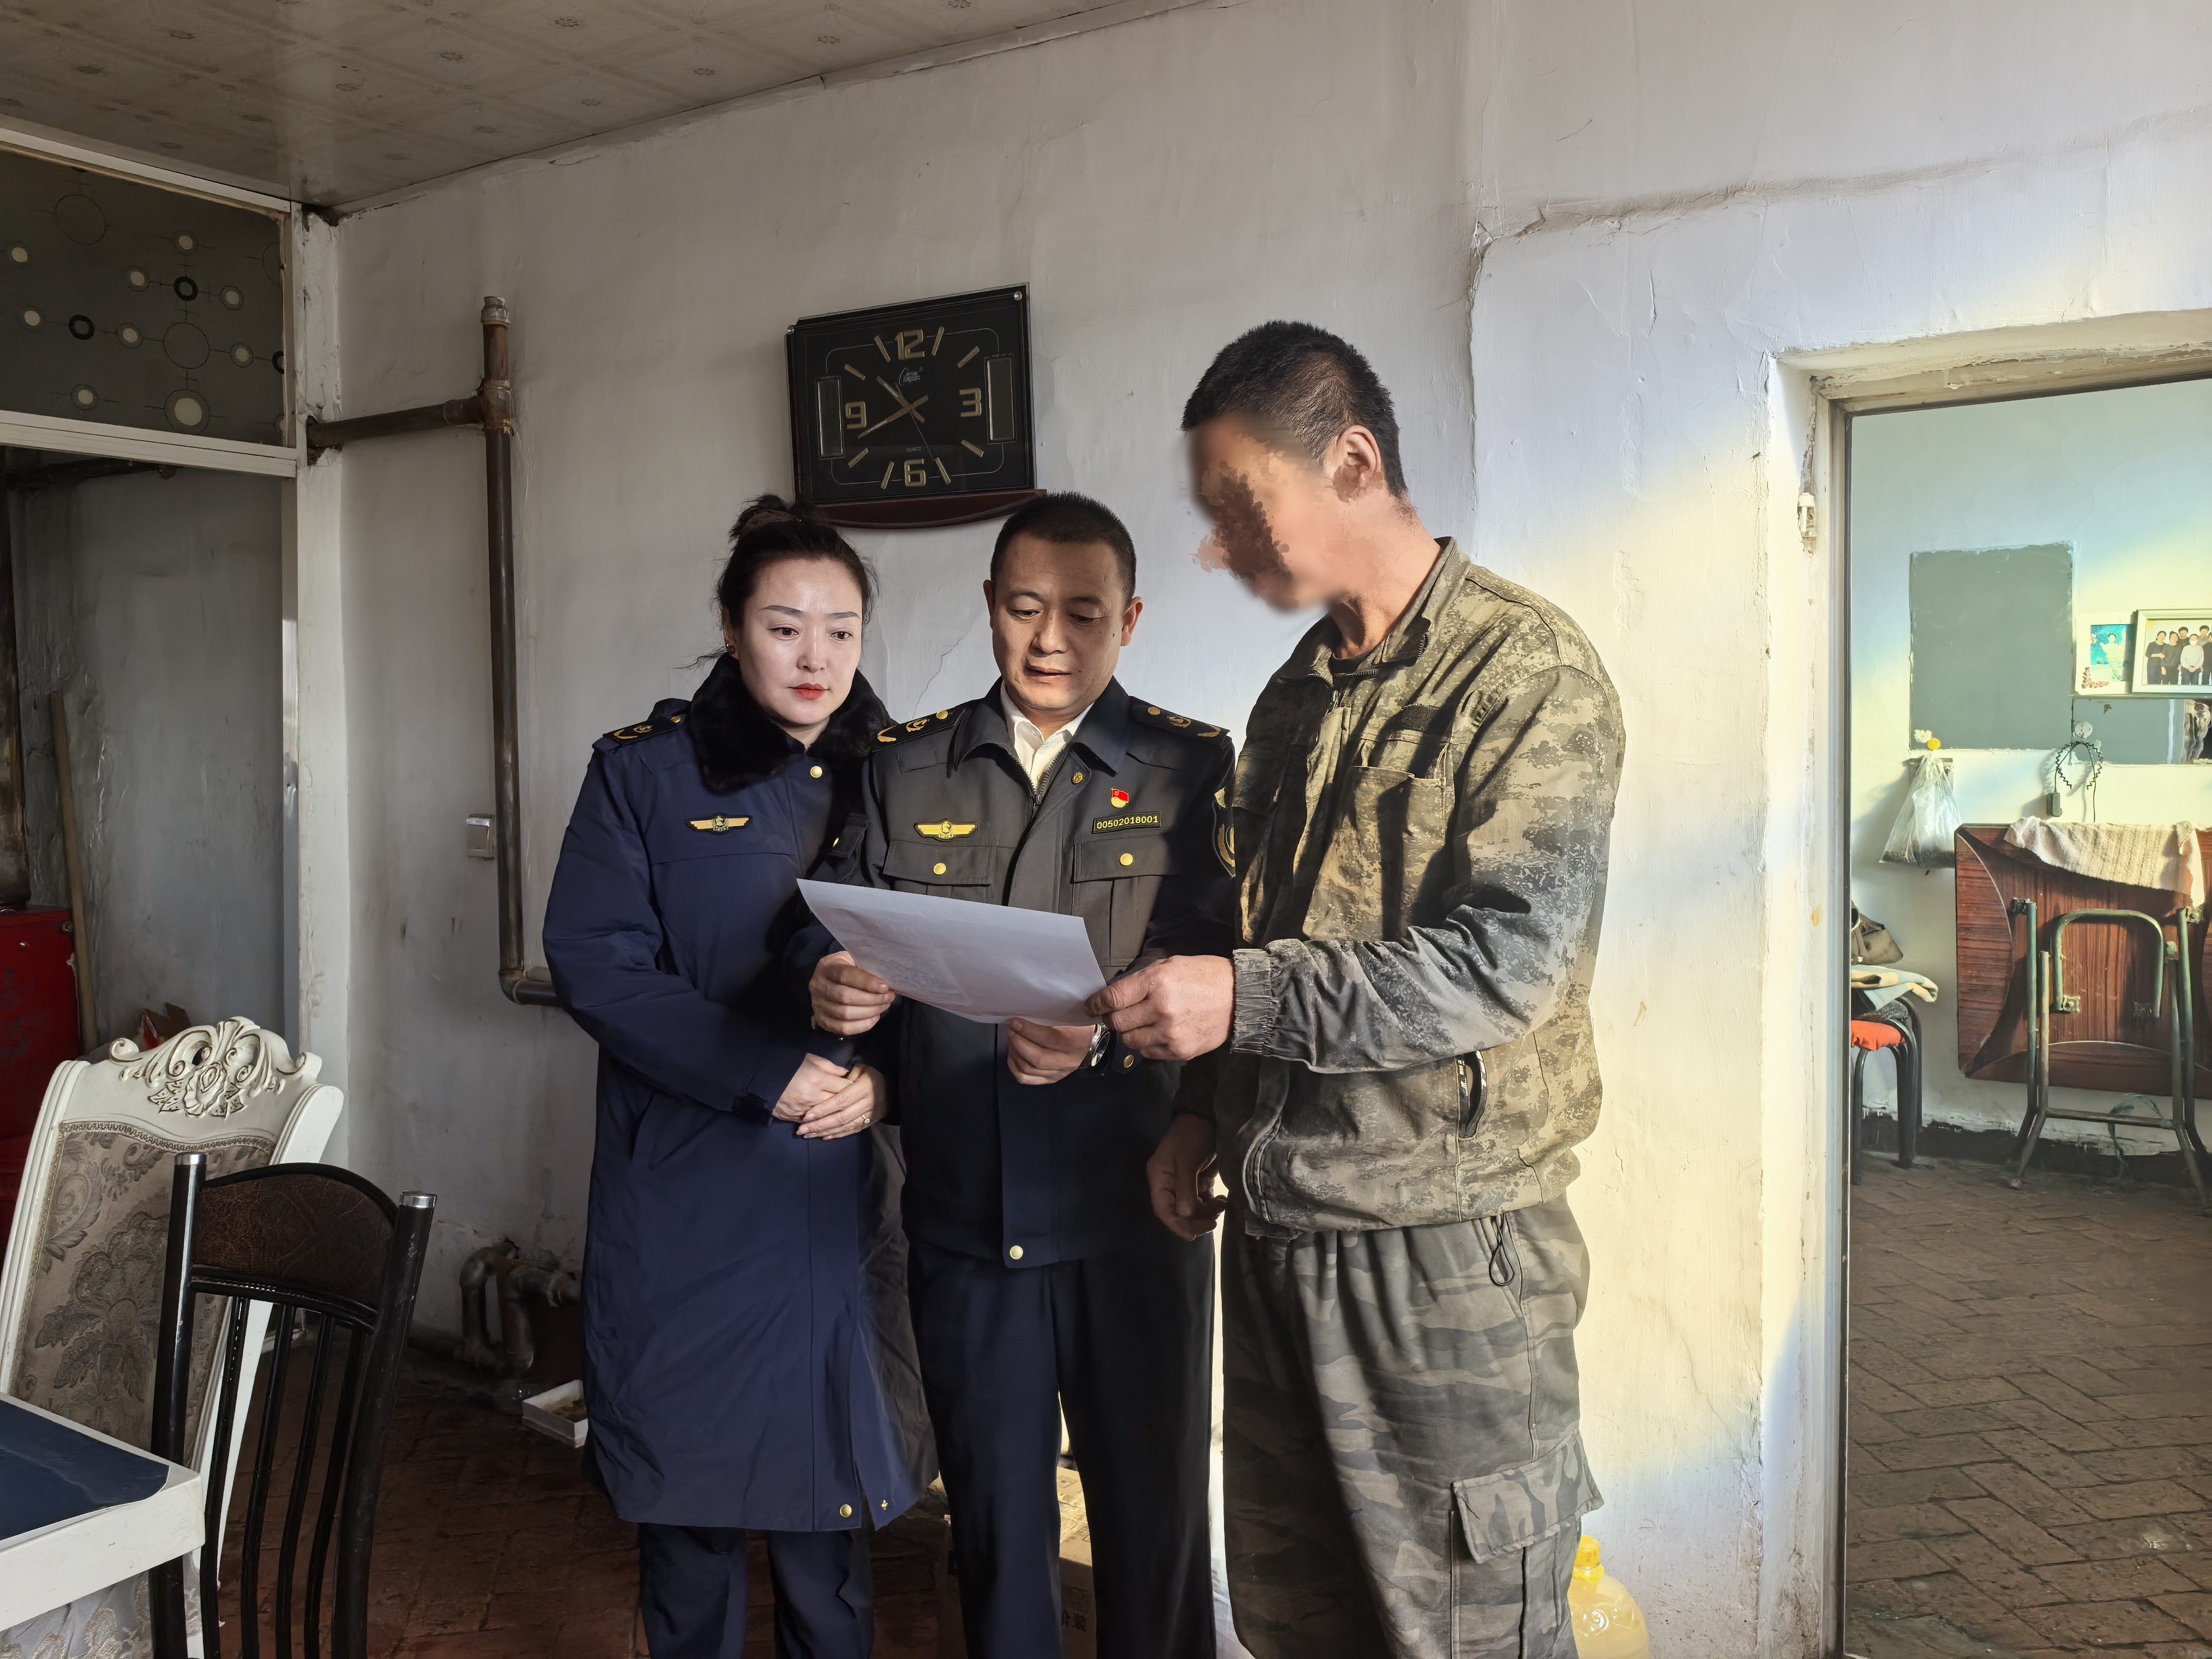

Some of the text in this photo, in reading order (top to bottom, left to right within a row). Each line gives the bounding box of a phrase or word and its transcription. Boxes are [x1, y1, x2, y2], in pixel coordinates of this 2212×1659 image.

[895, 329, 925, 360] 12
[845, 401, 866, 429] 9
[959, 388, 982, 417] 3
[904, 458, 927, 487] 6
[1097, 815, 1158, 829] 00502018001
